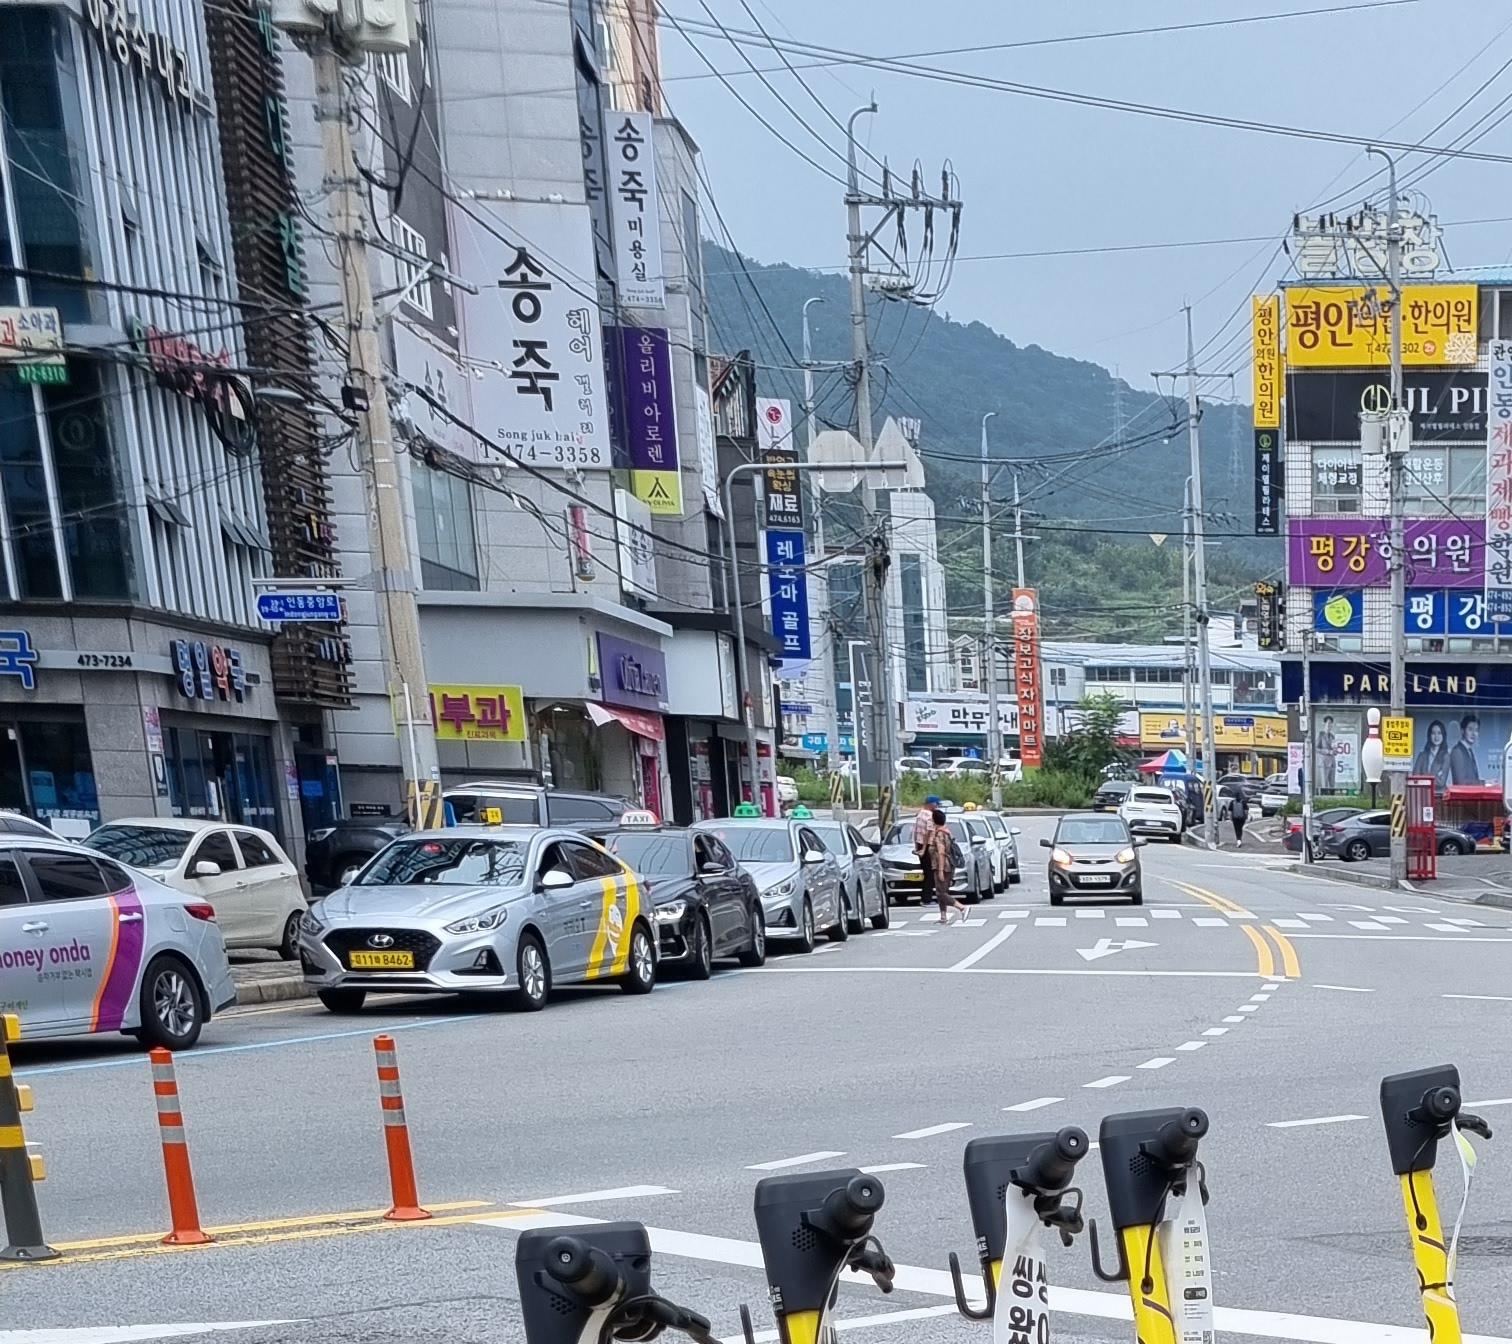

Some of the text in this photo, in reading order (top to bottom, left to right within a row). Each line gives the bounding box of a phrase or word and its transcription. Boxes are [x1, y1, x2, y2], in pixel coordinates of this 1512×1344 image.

[614, 116, 648, 213] 송죽
[627, 216, 647, 283] 미용실
[497, 246, 560, 413] 송죽
[566, 307, 592, 363] 헤어
[637, 333, 666, 465] 올리비아로렌
[1450, 387, 1488, 415] PI
[497, 428, 551, 442] Song juk
[1317, 457, 1358, 471] 다이어트
[768, 493, 799, 512] 재료
[286, 596, 336, 608] 인동중앙로
[776, 540, 802, 651] 레노마 골프
[77, 653, 133, 668] 473-7234
[171, 638, 244, 703] 명일약국
[1017, 626, 1037, 747] 장보고식자재마트
[1343, 673, 1478, 694] PARLAND
[949, 706, 1019, 732] 막무내
[1337, 742, 1351, 755] 50
[625, 815, 650, 824] TAXI
[49, 938, 91, 964] onda
[382, 954, 410, 967] 8462
